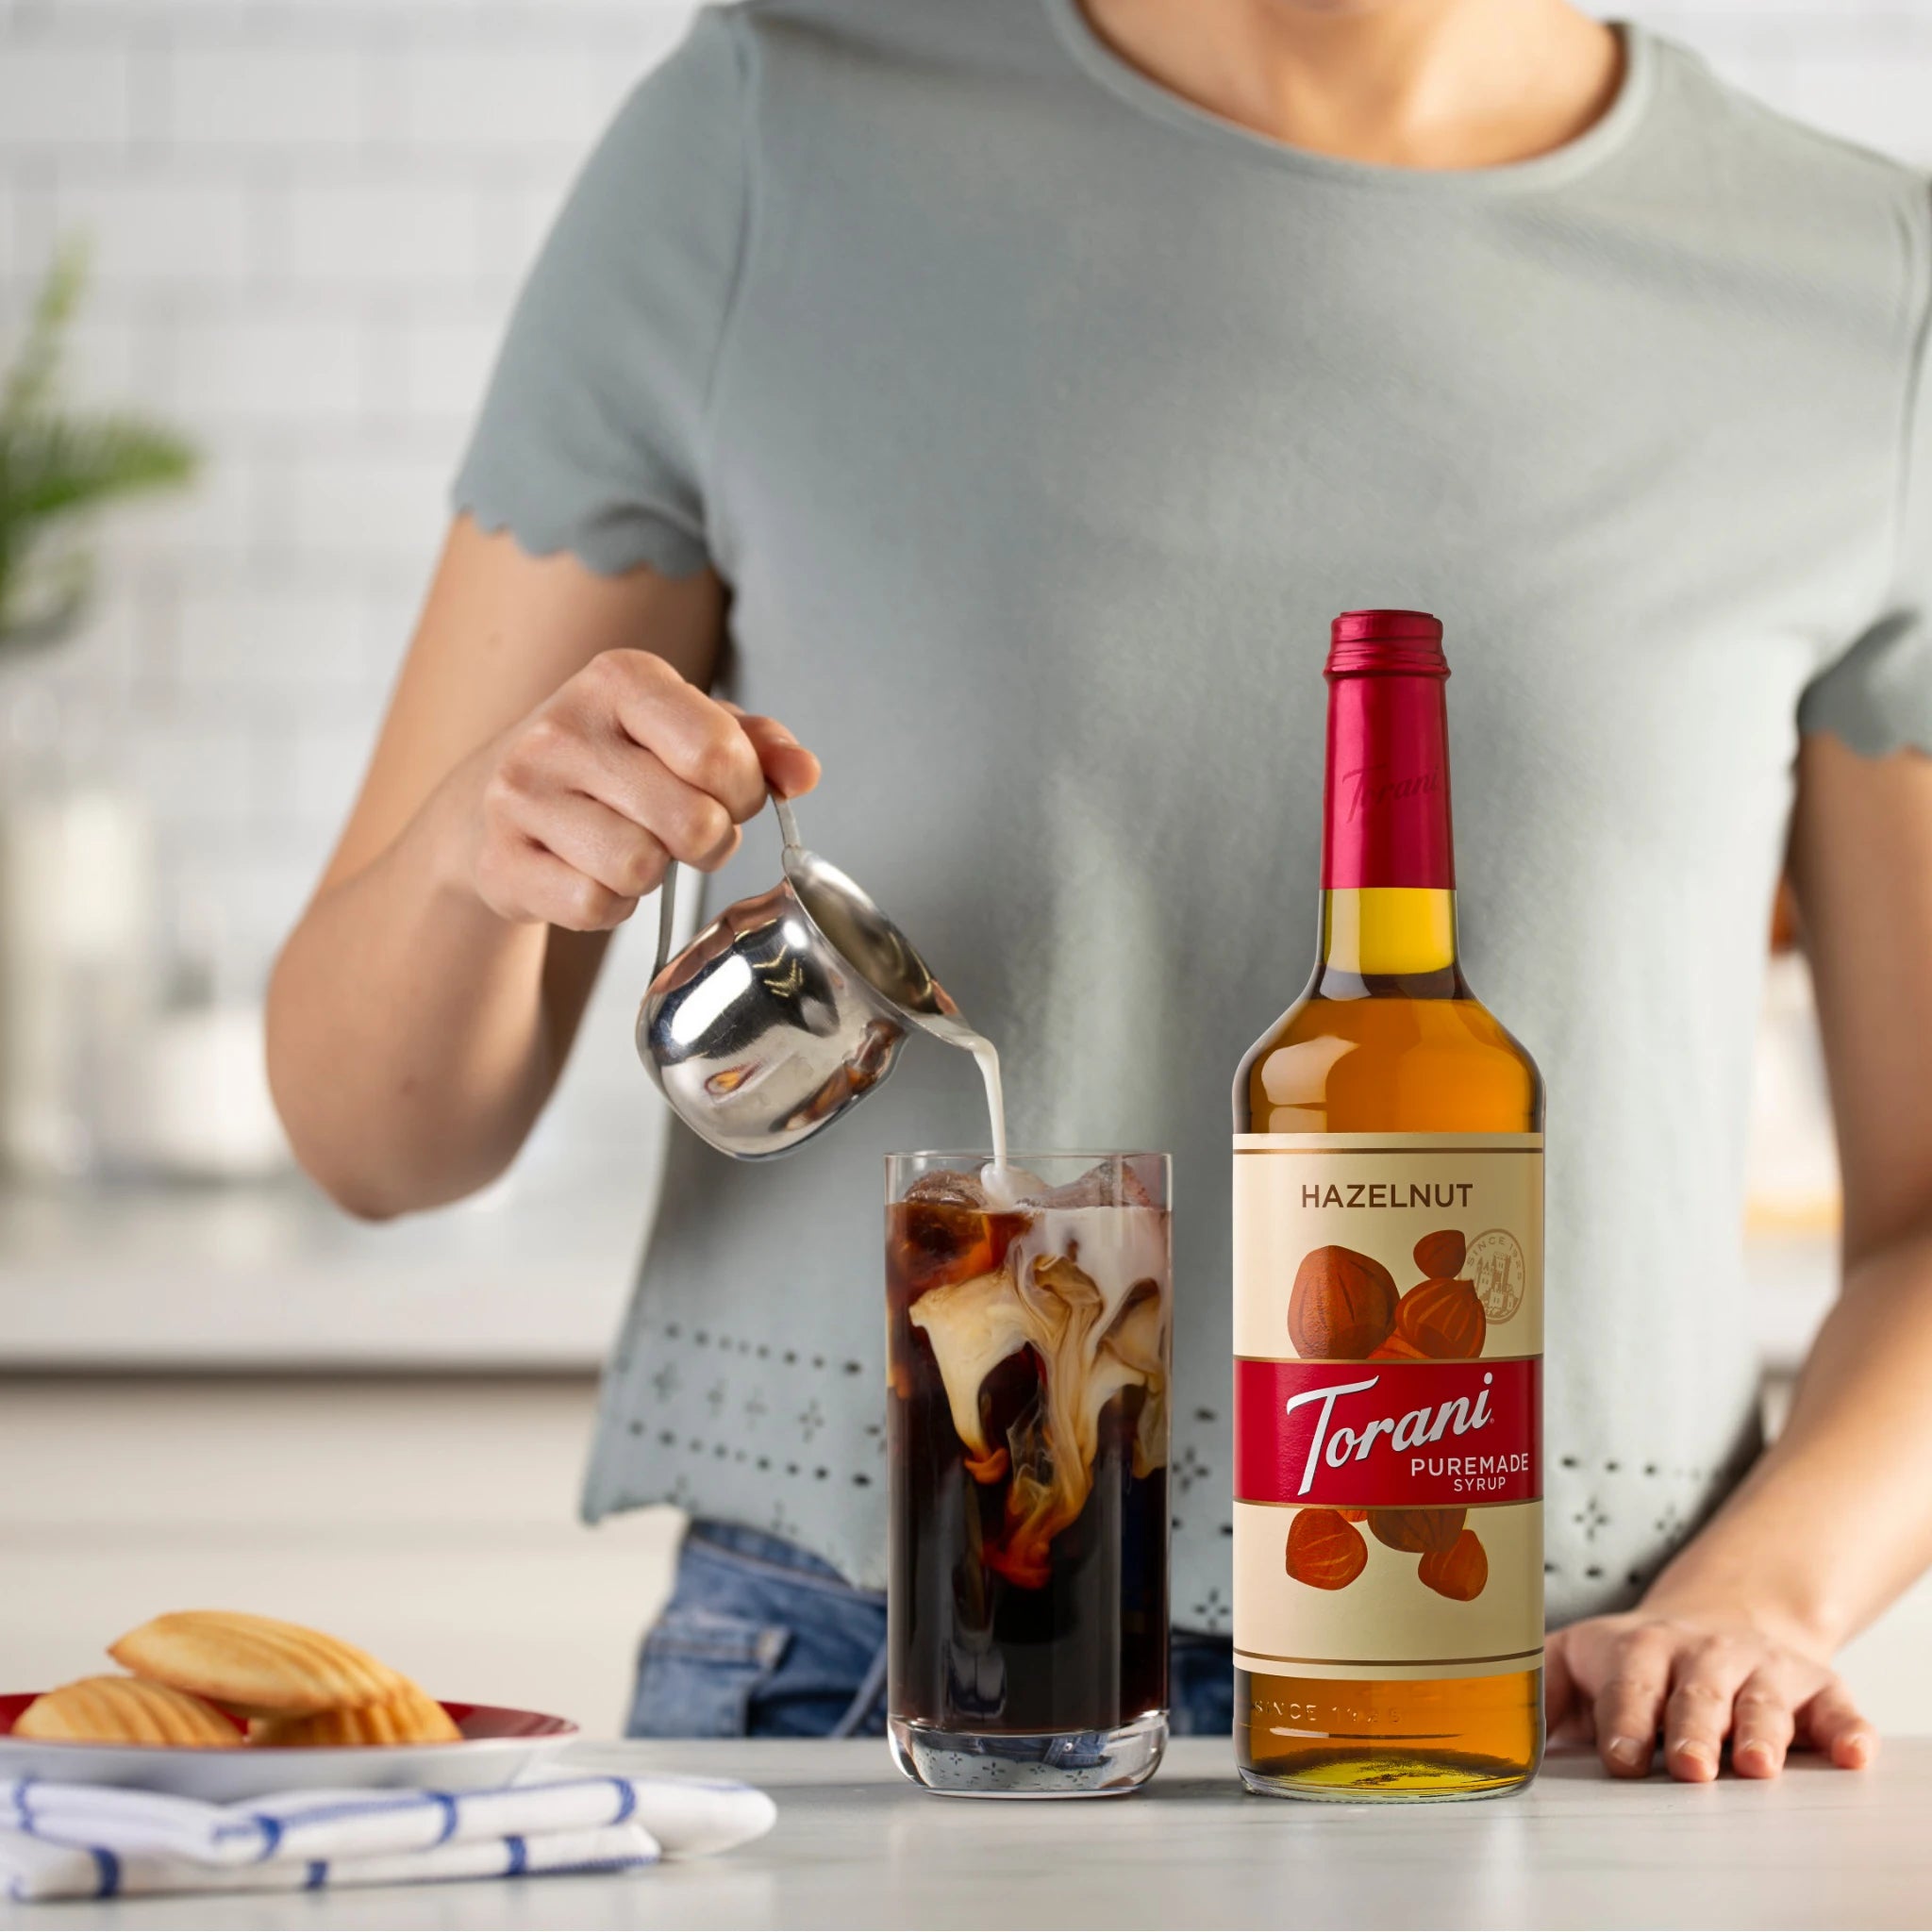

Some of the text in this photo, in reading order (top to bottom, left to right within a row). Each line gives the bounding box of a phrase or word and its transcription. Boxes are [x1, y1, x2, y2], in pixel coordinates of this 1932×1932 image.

[1341, 762, 1440, 824] Torani
[1302, 1184, 1474, 1208] HAZELNUT
[1467, 1237, 1506, 1267] SINCE
[1287, 1372, 1493, 1496] Torani
[1411, 1453, 1529, 1476] PUREMADE
[1454, 1476, 1507, 1492] SYRUP
[1254, 1700, 1317, 1722] SINCE
